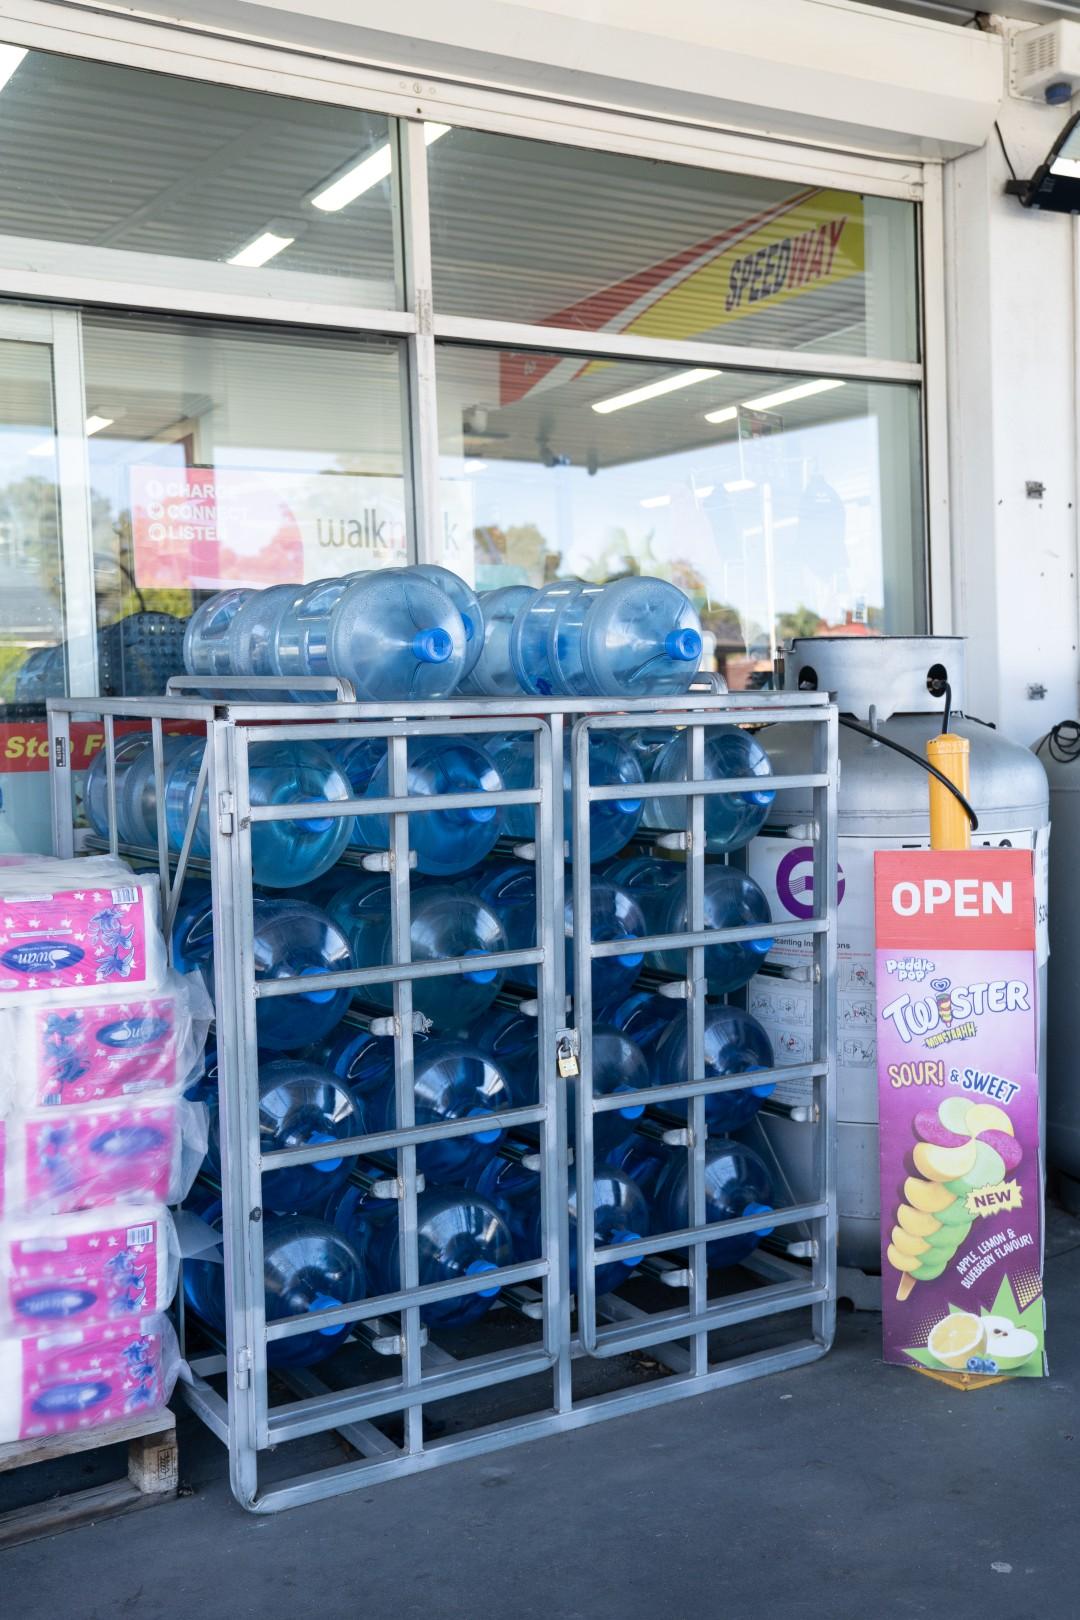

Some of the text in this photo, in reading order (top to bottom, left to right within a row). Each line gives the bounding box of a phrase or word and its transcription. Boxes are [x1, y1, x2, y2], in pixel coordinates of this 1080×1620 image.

[725, 216, 847, 312] SPEEDWAY
[892, 879, 1013, 917] OPEN
[888, 1060, 1019, 1103] SOUR! & SWEET
[974, 1189, 1011, 1208] NEW
[956, 1228, 1016, 1275] APPLE, LEMON &
[960, 1233, 1034, 1289] BLUEBERRY FLAVOUR!
